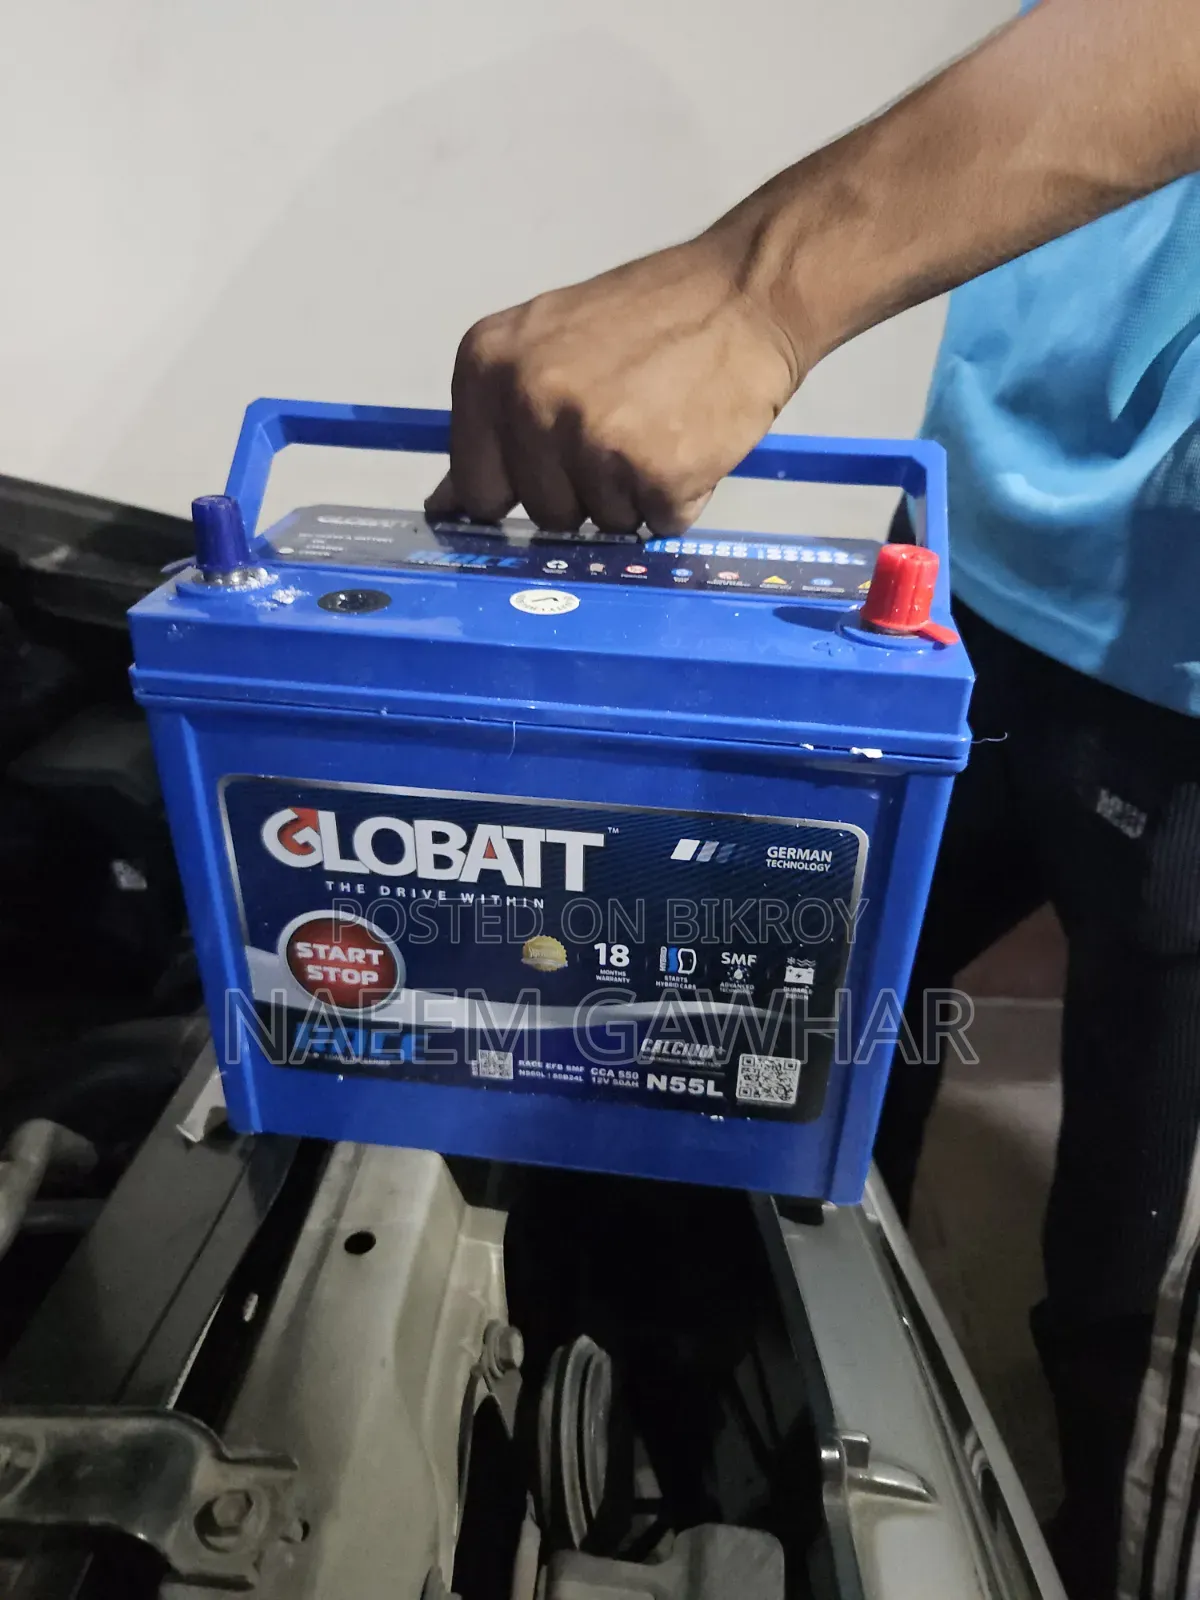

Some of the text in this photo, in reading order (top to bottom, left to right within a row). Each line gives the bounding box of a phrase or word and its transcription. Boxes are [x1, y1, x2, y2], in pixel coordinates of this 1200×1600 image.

[261, 806, 604, 892] GLOBATT
[767, 846, 833, 863] GERMAN
[766, 858, 831, 872] TECHNOLOGY
[325, 880, 545, 910] THE DRIVE WITHIN
[295, 942, 385, 966] START
[594, 942, 631, 968] 18
[720, 951, 758, 967] SMF
[306, 964, 380, 986] STOP
[595, 974, 631, 984] WARRANTY
[599, 968, 627, 978] MONTHS
[664, 975, 689, 984] STARTS
[655, 980, 680, 989] HYBRID
[518, 1059, 544, 1069] RACE
[590, 1067, 640, 1081] CCA 550
[591, 1075, 610, 1085] 12V
[646, 1073, 724, 1097] N55L
